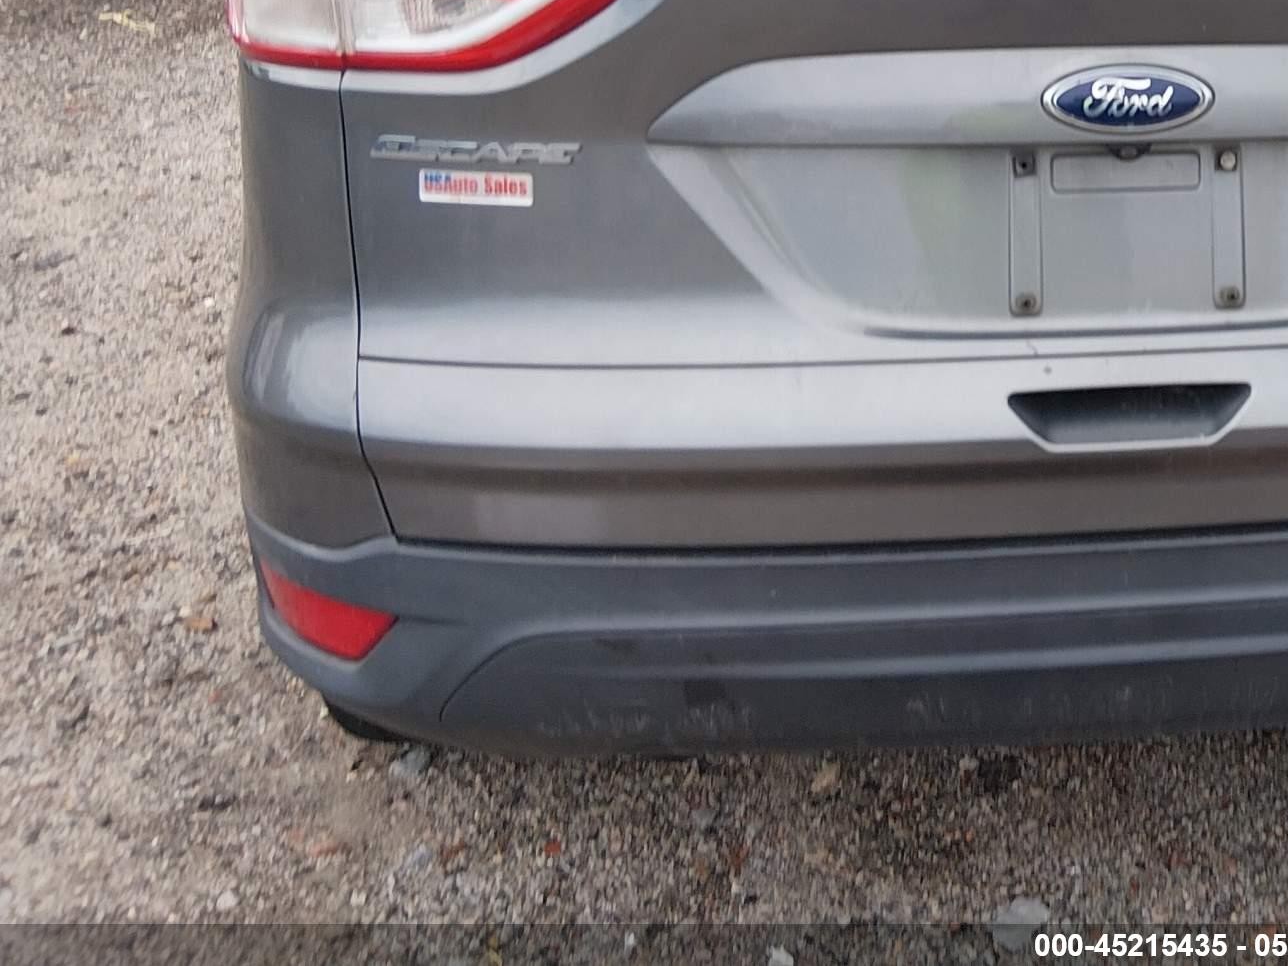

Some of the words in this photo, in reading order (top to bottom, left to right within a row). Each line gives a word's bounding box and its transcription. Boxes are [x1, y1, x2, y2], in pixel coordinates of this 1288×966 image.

[1083, 76, 1174, 117] Ford
[370, 134, 583, 165] ESCAPE
[484, 173, 528, 197] Sales
